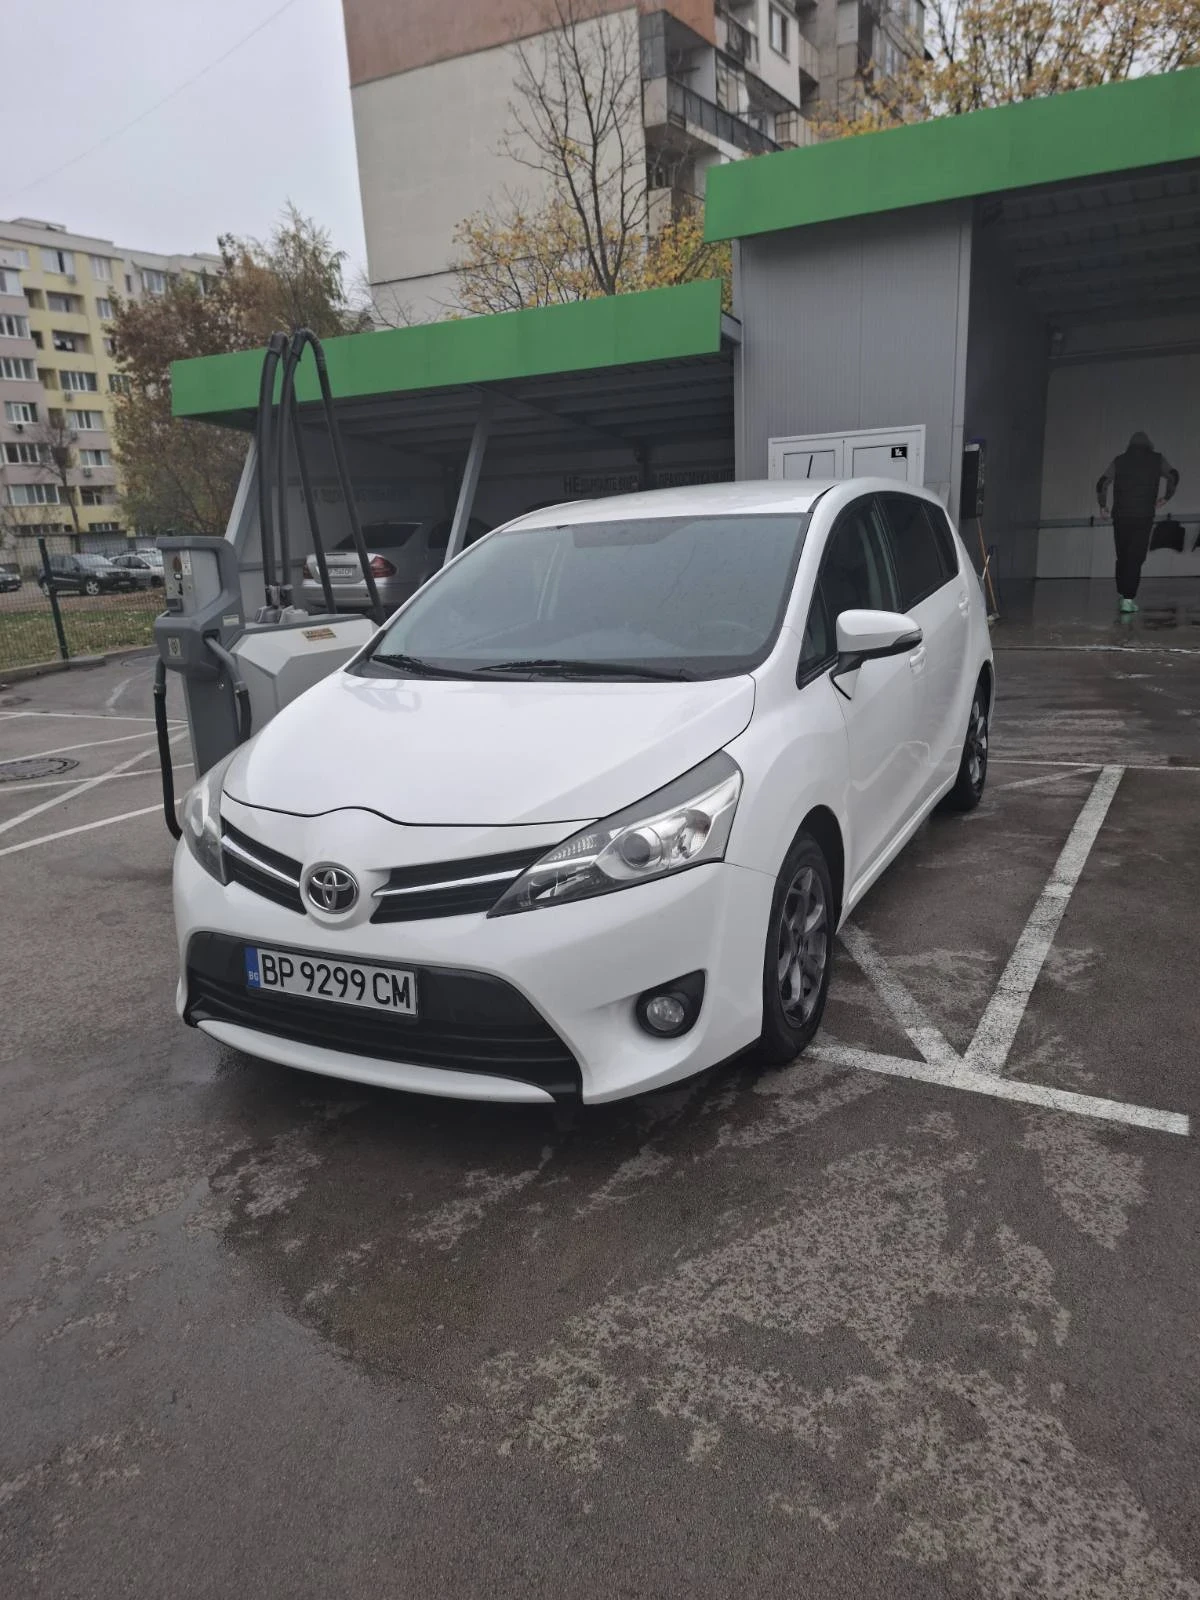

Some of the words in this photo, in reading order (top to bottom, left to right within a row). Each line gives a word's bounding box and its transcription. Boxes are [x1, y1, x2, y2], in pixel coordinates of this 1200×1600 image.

[248, 970, 259, 981] BG
[261, 953, 294, 987] BP
[300, 961, 366, 1001] 9299
[372, 972, 411, 1009] CM
